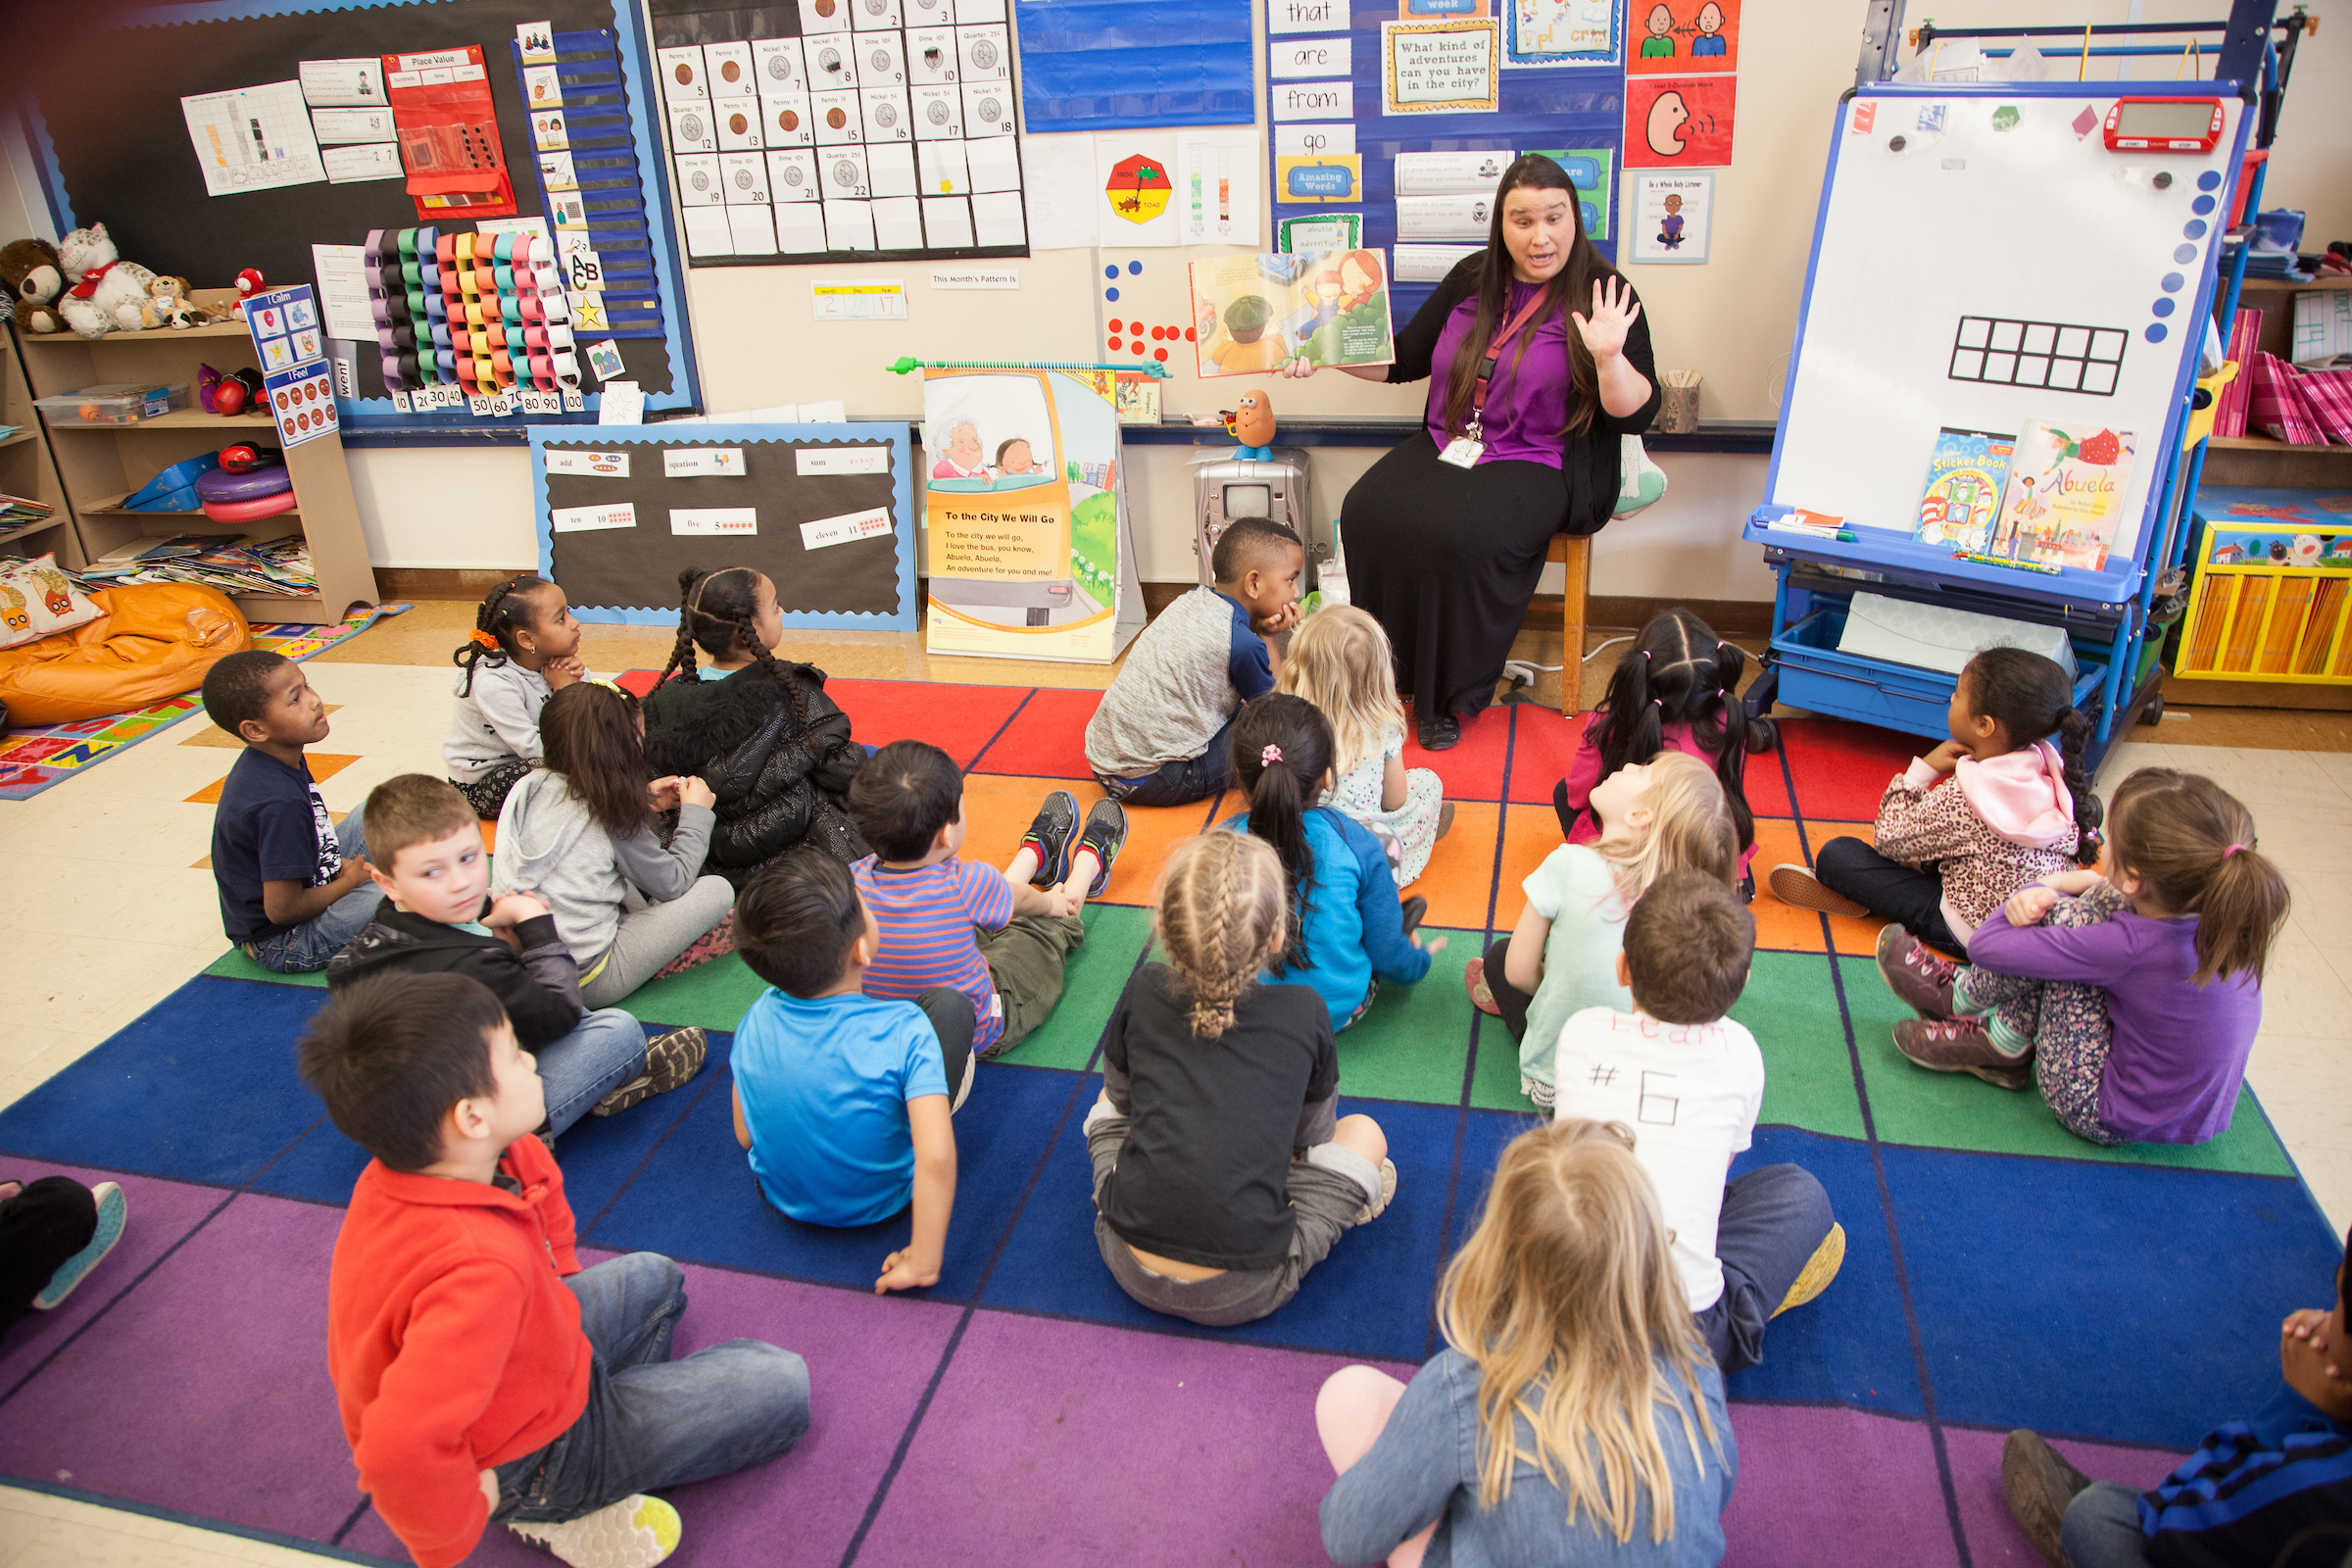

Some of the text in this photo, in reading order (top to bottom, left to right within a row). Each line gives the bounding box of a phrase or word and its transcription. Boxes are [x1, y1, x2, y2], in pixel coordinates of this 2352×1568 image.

[941, 12, 948, 21] 3
[1287, 1, 1332, 22] that
[843, 18, 847, 27] 1
[891, 16, 898, 25] 2
[1539, 24, 1552, 50] pl
[1570, 29, 1590, 41] cr
[1401, 39, 1486, 53] What kind of
[433, 55, 455, 64] Value
[1295, 49, 1327, 65] are
[1409, 55, 1477, 65] adventures
[845, 72, 852, 81] 8
[945, 71, 955, 80] 10
[999, 67, 1005, 77] 11
[1429, 69, 1450, 79] you
[1457, 67, 1486, 75] have
[896, 73, 902, 82] 9
[745, 84, 752, 93] 6
[795, 79, 801, 89] 7
[1407, 80, 1419, 89] in
[1451, 78, 1479, 90] city?
[698, 86, 704, 96] 5
[1287, 89, 1338, 108] from
[949, 125, 957, 135] 17
[1002, 122, 1011, 132] 18
[800, 132, 809, 142] 14
[848, 130, 857, 140] 15
[897, 128, 906, 138] 16
[703, 139, 711, 148] 12
[749, 136, 758, 146] 13
[1303, 135, 1326, 156] go
[1298, 172, 1342, 182] Amazing
[1674, 180, 1684, 189] Body
[805, 188, 813, 198] 21
[854, 186, 866, 195] 22
[710, 192, 719, 202] 19
[752, 192, 763, 201] 20
[267, 292, 291, 305] I Calm
[825, 296, 836, 313] 2
[880, 297, 894, 316] 17
[288, 367, 309, 380] I Feel
[337, 363, 349, 395] went
[430, 392, 445, 402] 30
[450, 390, 461, 402] 40
[397, 397, 407, 409] 10
[473, 400, 487, 412] 50
[494, 401, 508, 412] 60
[525, 398, 539, 409] 80
[543, 398, 558, 410] 90
[564, 396, 581, 407] 100
[668, 460, 698, 468] equation
[1933, 454, 2007, 472] Sticker Book
[2040, 468, 2115, 496] Abuela
[980, 513, 999, 522] City
[715, 521, 720, 530] 5
[815, 526, 858, 540] eleven 11
[957, 564, 994, 573] adventure
[1590, 1063, 1679, 1126] # 6
